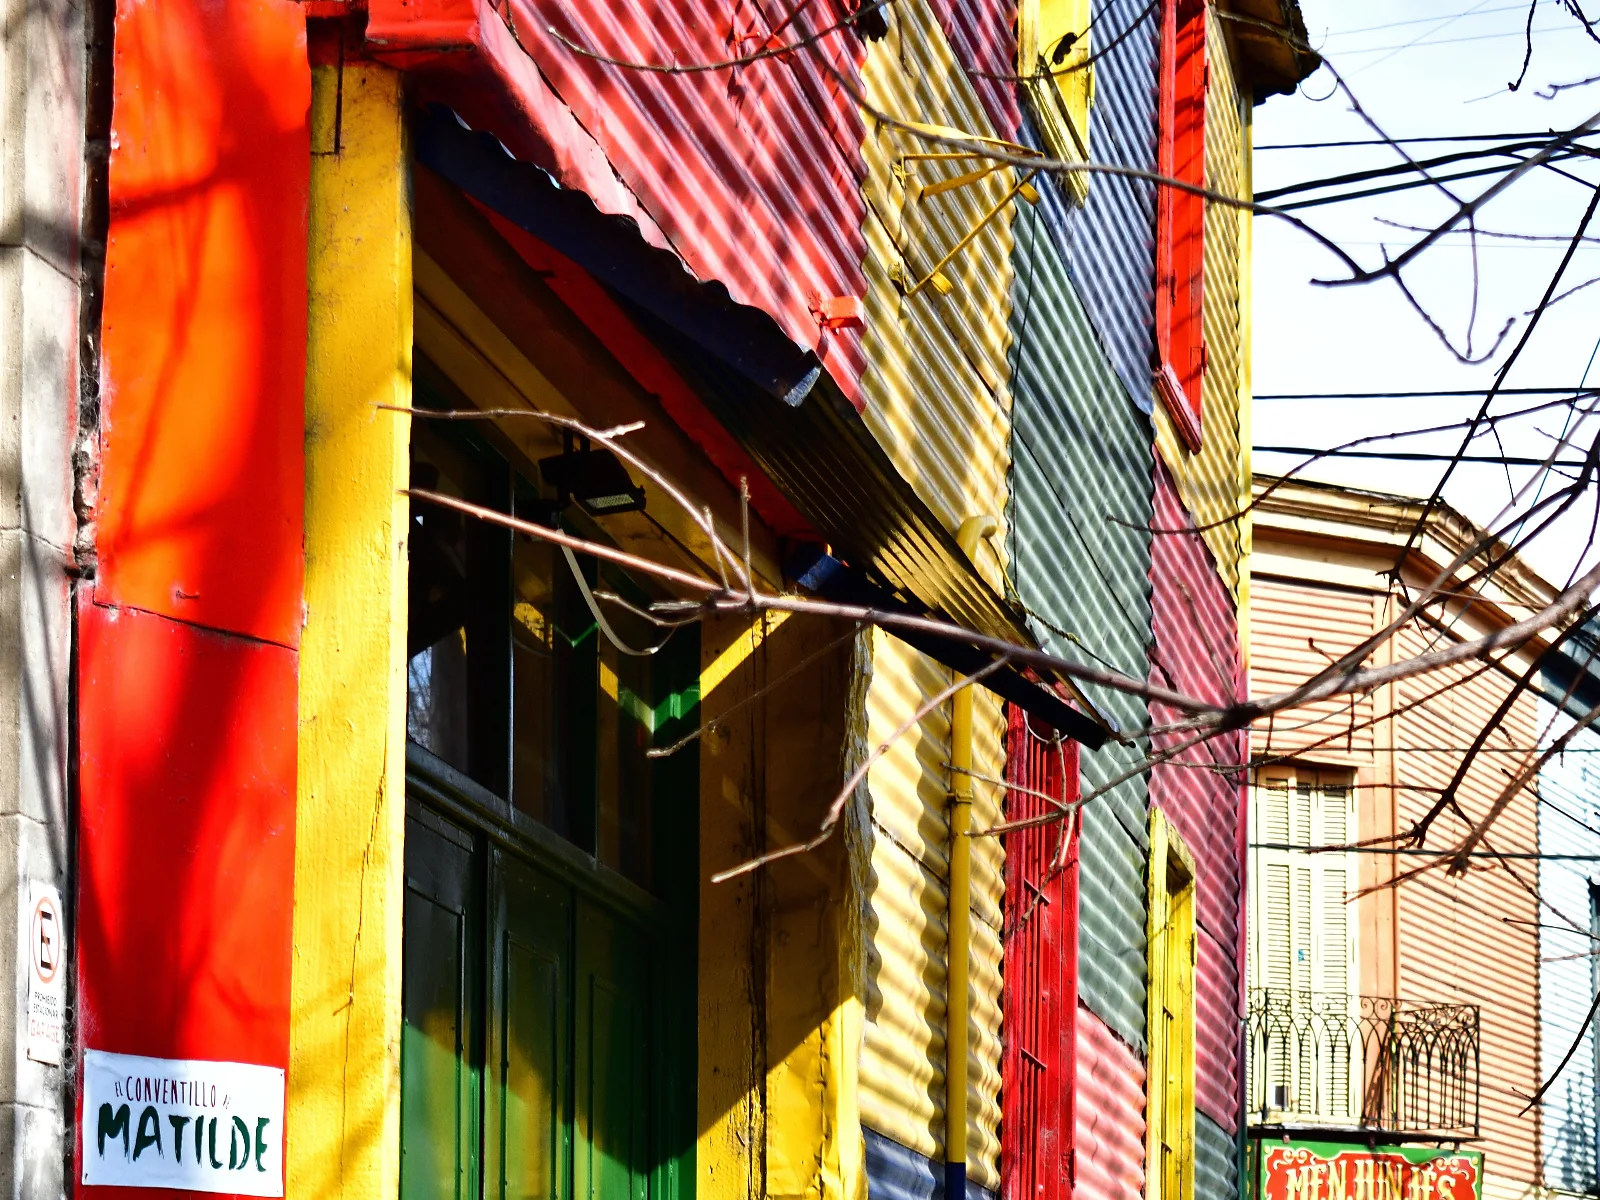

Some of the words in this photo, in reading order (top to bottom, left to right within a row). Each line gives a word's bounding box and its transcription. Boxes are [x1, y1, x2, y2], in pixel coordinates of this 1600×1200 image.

[31, 1019, 60, 1043] GARAGE
[115, 1081, 123, 1097] EL
[126, 1076, 216, 1107] CONVENTILLO
[98, 1102, 270, 1172] MATILDE
